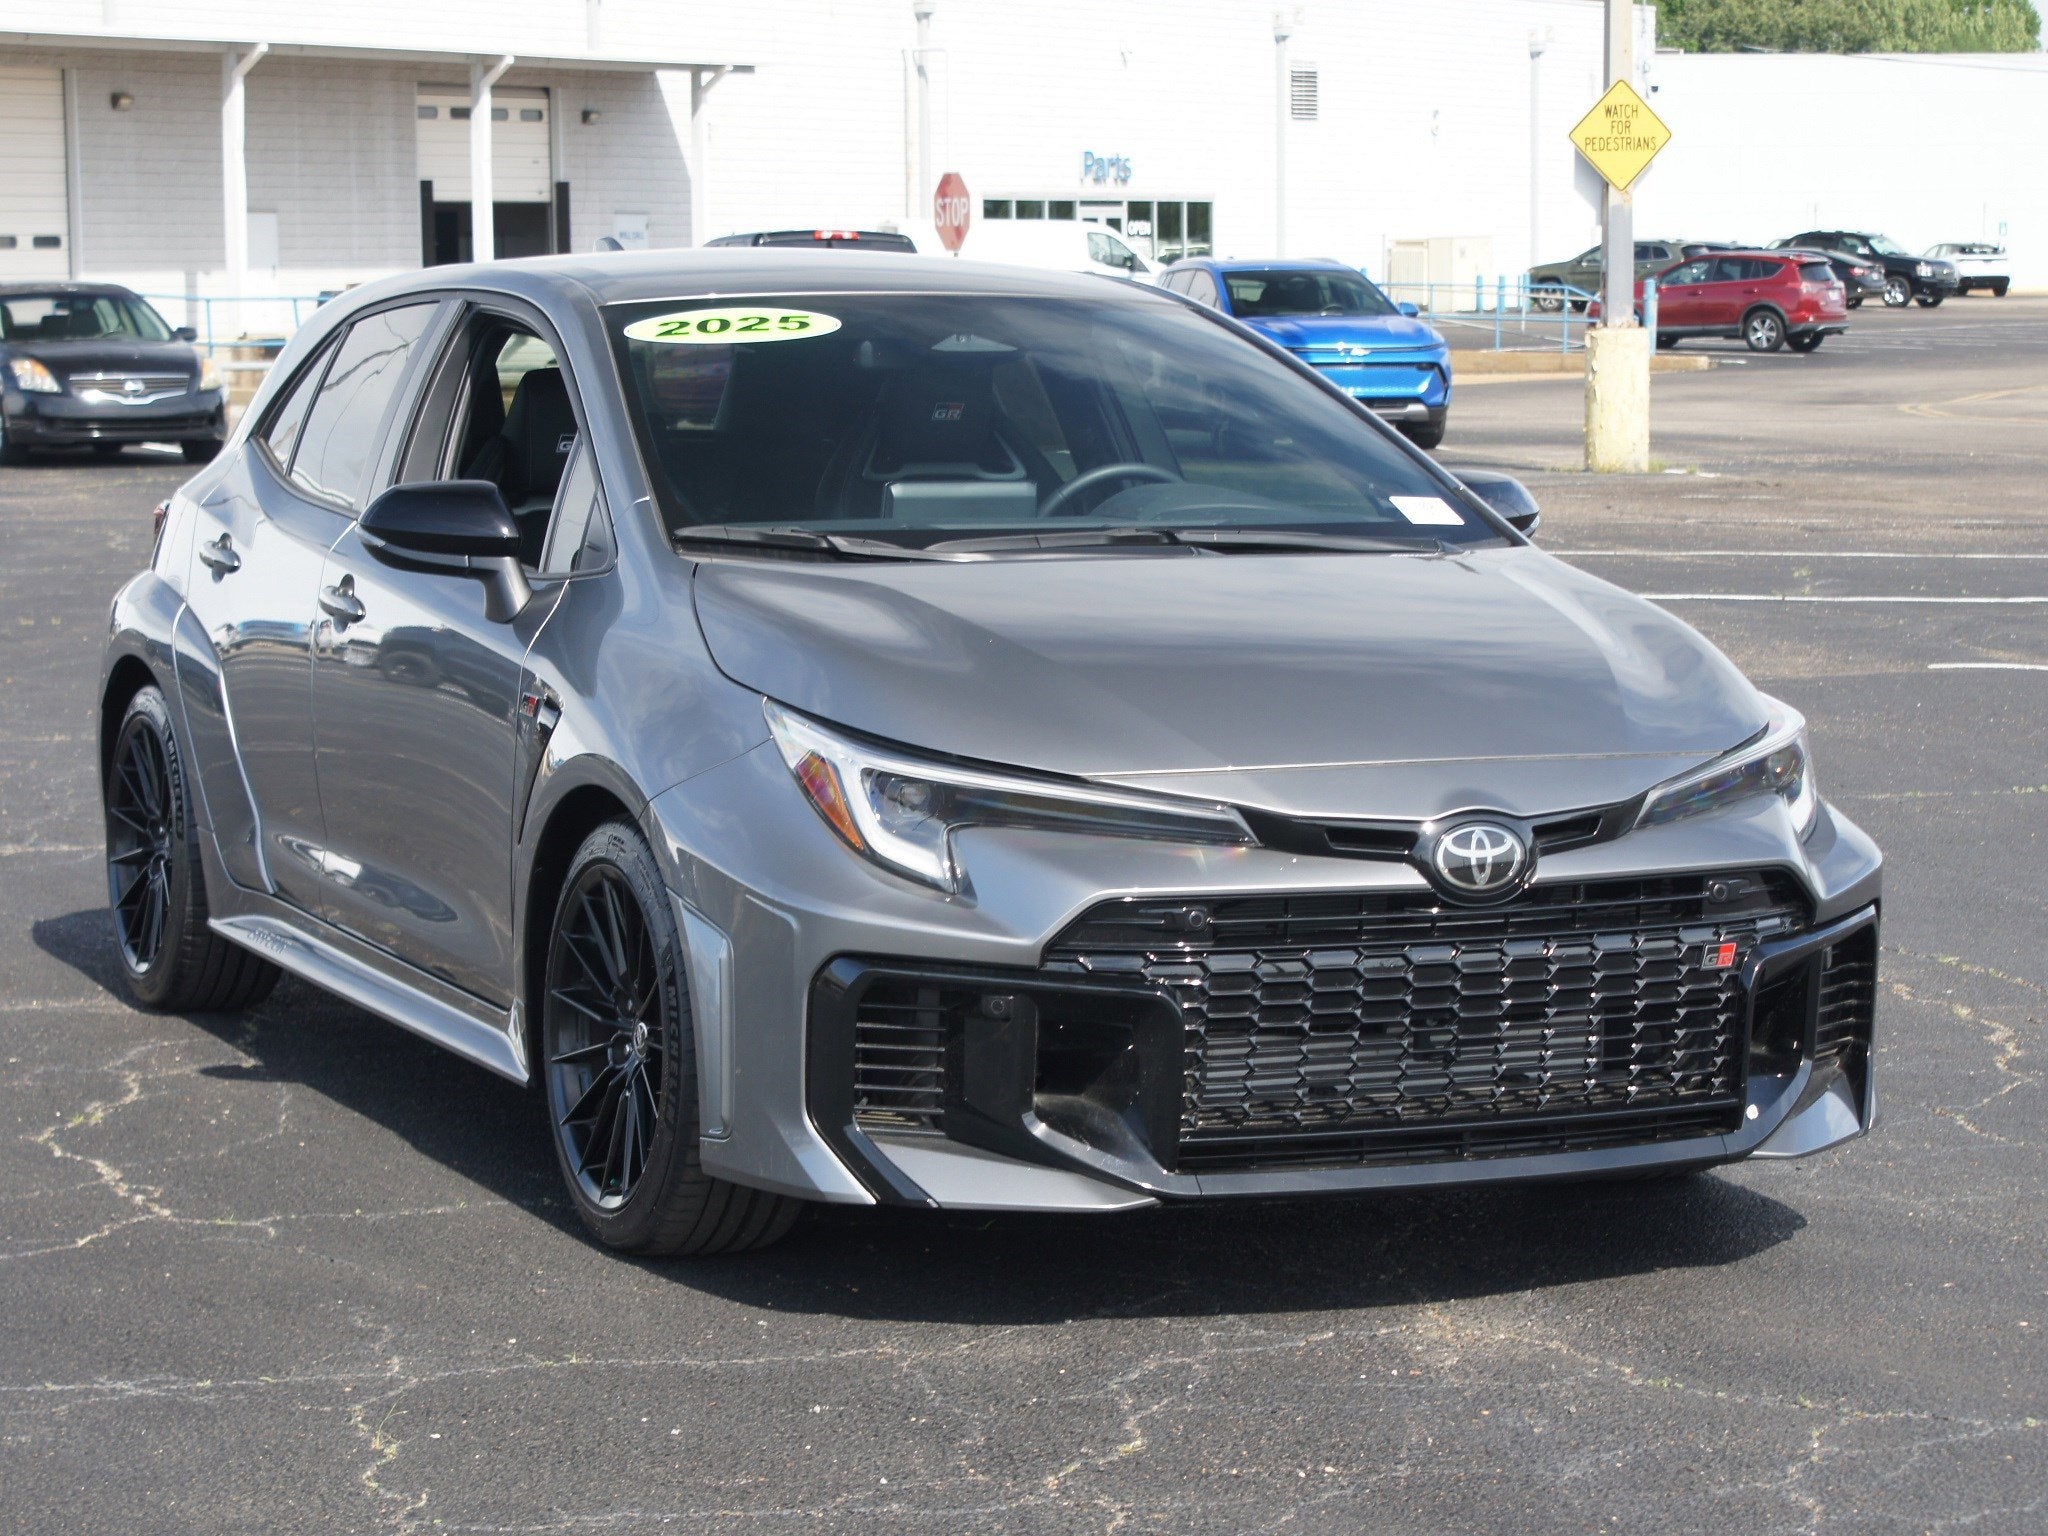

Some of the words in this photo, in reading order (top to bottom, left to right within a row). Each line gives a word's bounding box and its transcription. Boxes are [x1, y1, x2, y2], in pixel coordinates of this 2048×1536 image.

[1604, 104, 1639, 119] WATCH
[1610, 120, 1631, 135] FOR
[1584, 136, 1657, 152] PEDESTRIANS
[1084, 151, 1131, 180] Parts
[936, 198, 968, 227] STOP
[655, 315, 811, 337] 2025
